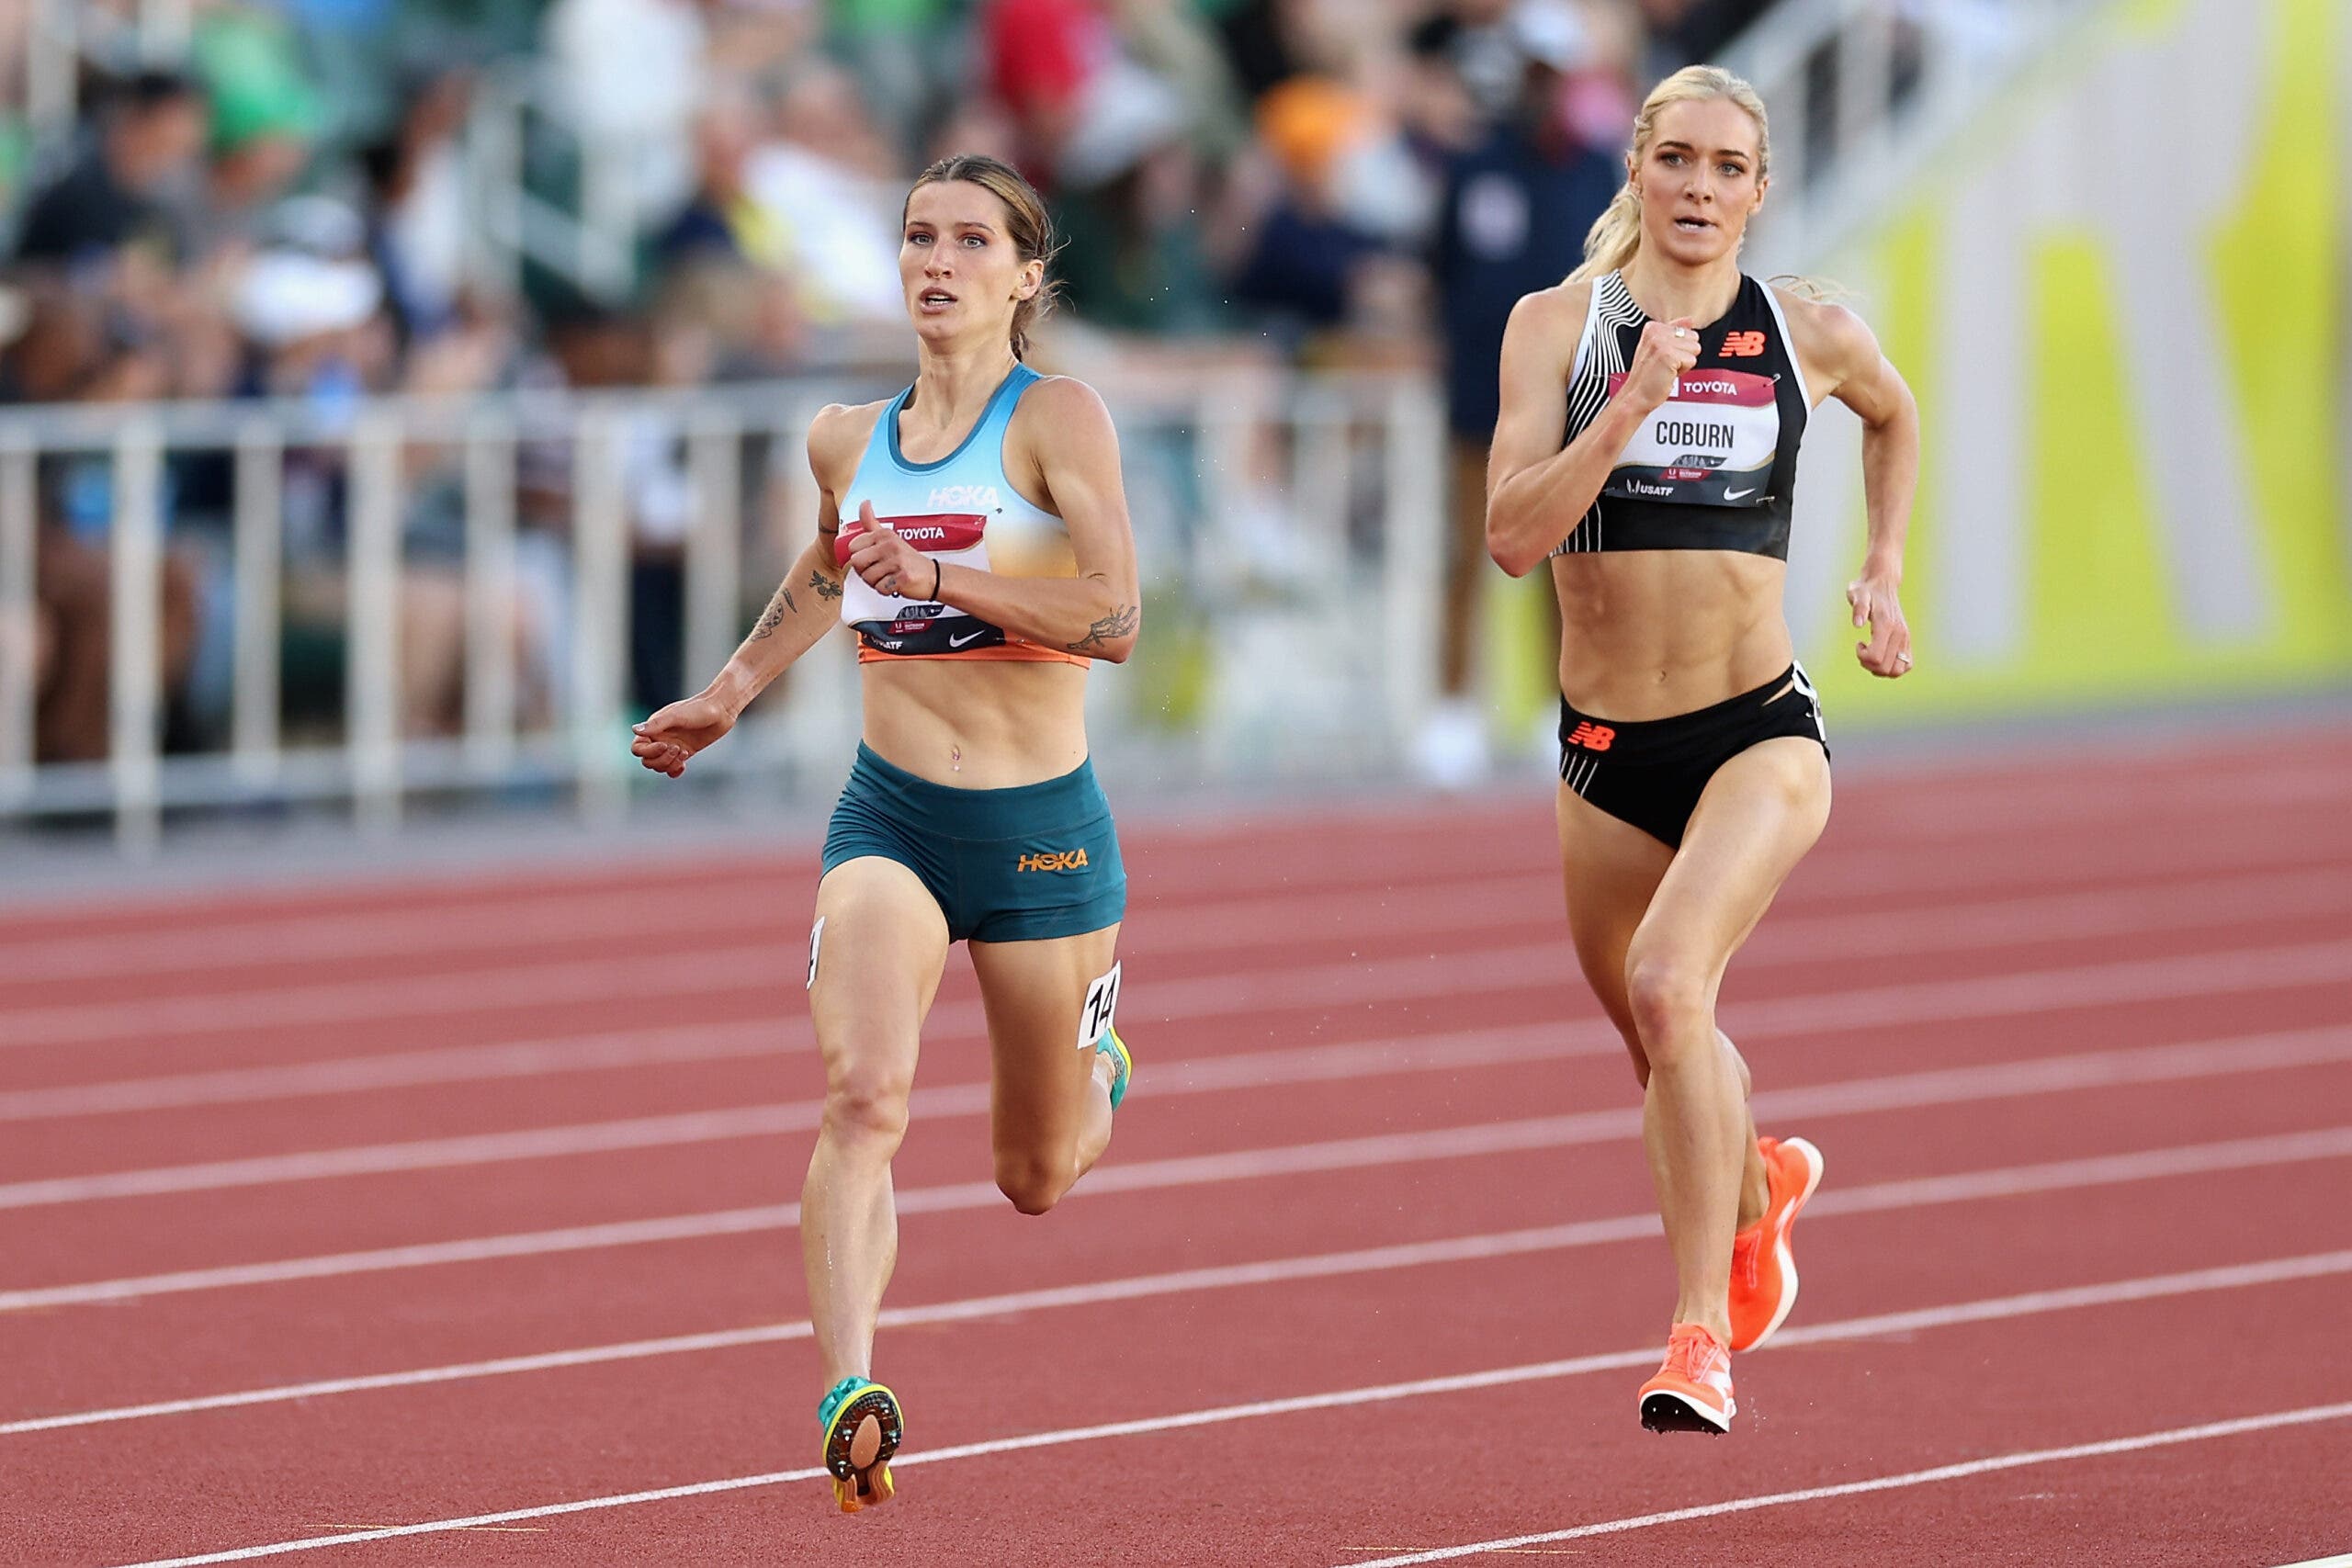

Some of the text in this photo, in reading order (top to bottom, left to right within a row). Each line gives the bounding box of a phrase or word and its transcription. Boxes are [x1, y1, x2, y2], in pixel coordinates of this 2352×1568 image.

[1718, 331, 1766, 357] NB
[1683, 381, 1737, 396] TOYOTA
[1656, 421, 1735, 448] COBURN
[926, 485, 1000, 509] HOKA
[1639, 484, 1674, 497] USATF
[897, 526, 945, 540] TOYOTA
[1017, 848, 1089, 872] HOKA
[1088, 973, 1117, 1040] 14
